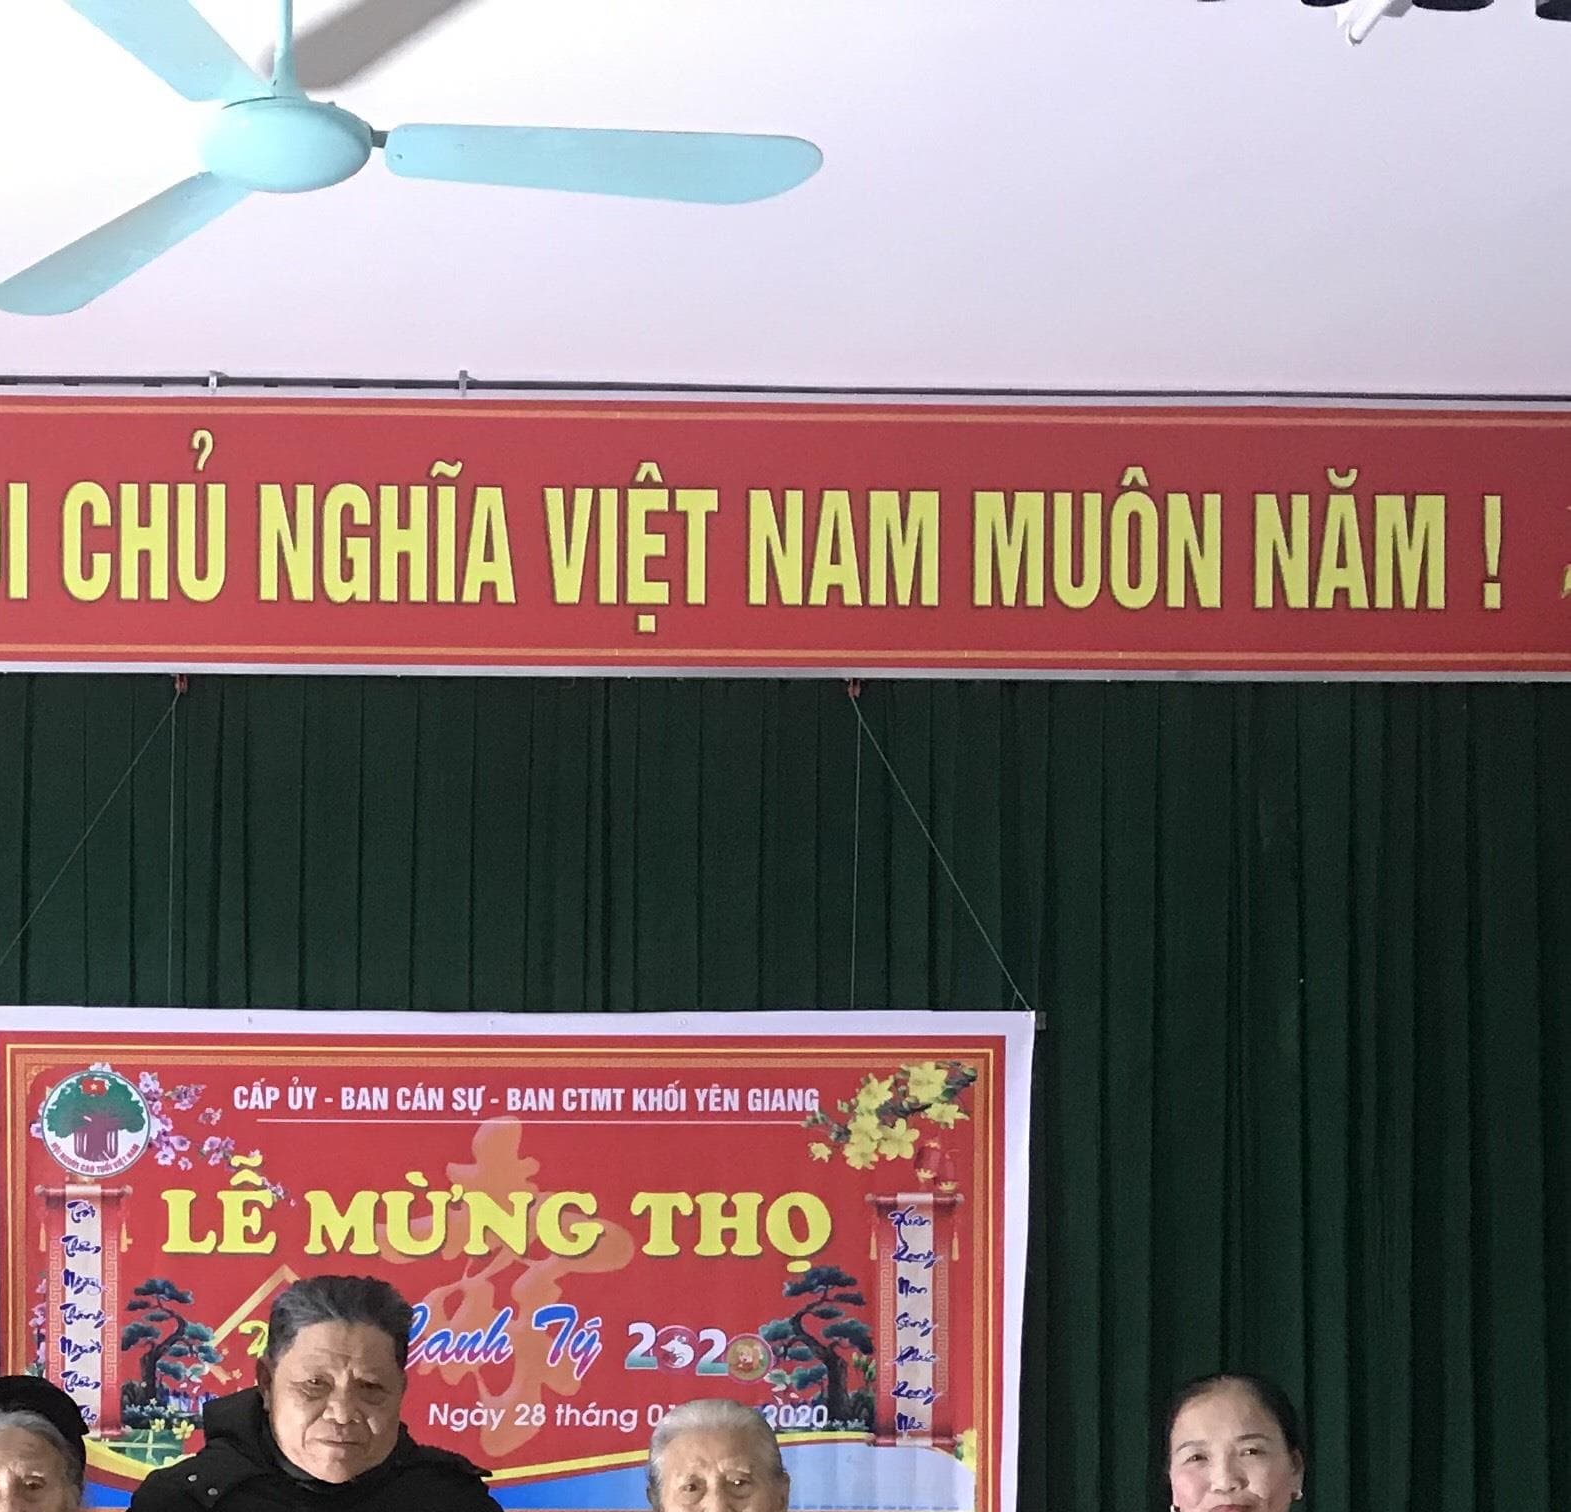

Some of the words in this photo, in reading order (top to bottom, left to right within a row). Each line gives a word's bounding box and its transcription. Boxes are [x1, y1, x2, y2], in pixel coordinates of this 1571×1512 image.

[62, 429, 226, 602] CHỦ
[259, 460, 516, 603] NGHĨA
[544, 462, 719, 632] VIỆT
[748, 489, 940, 606] NAM
[974, 466, 1222, 609] MUÔN
[1255, 468, 1446, 609] NĂM
[1484, 495, 1502, 609] !
[233, 1078, 280, 1110] CẤP
[287, 1076, 317, 1110] ỦY
[341, 1087, 389, 1111] BAN
[396, 1082, 444, 1111] CÁN
[451, 1085, 486, 1116] SỰ
[507, 1087, 555, 1111] BAN
[562, 1088, 625, 1111] CTMT
[632, 1080, 687, 1112] KHỐI
[694, 1084, 740, 1112] YÊN
[747, 1088, 820, 1112] GIANG
[160, 1154, 278, 1255] LỄ
[303, 1171, 605, 1259] MỪNG
[630, 1191, 833, 1274] THỌ
[531, 1303, 603, 1381] Tý
[428, 1401, 506, 1432] Ngày
[513, 1403, 547, 1427] 28
[555, 1402, 640, 1433] tháng
